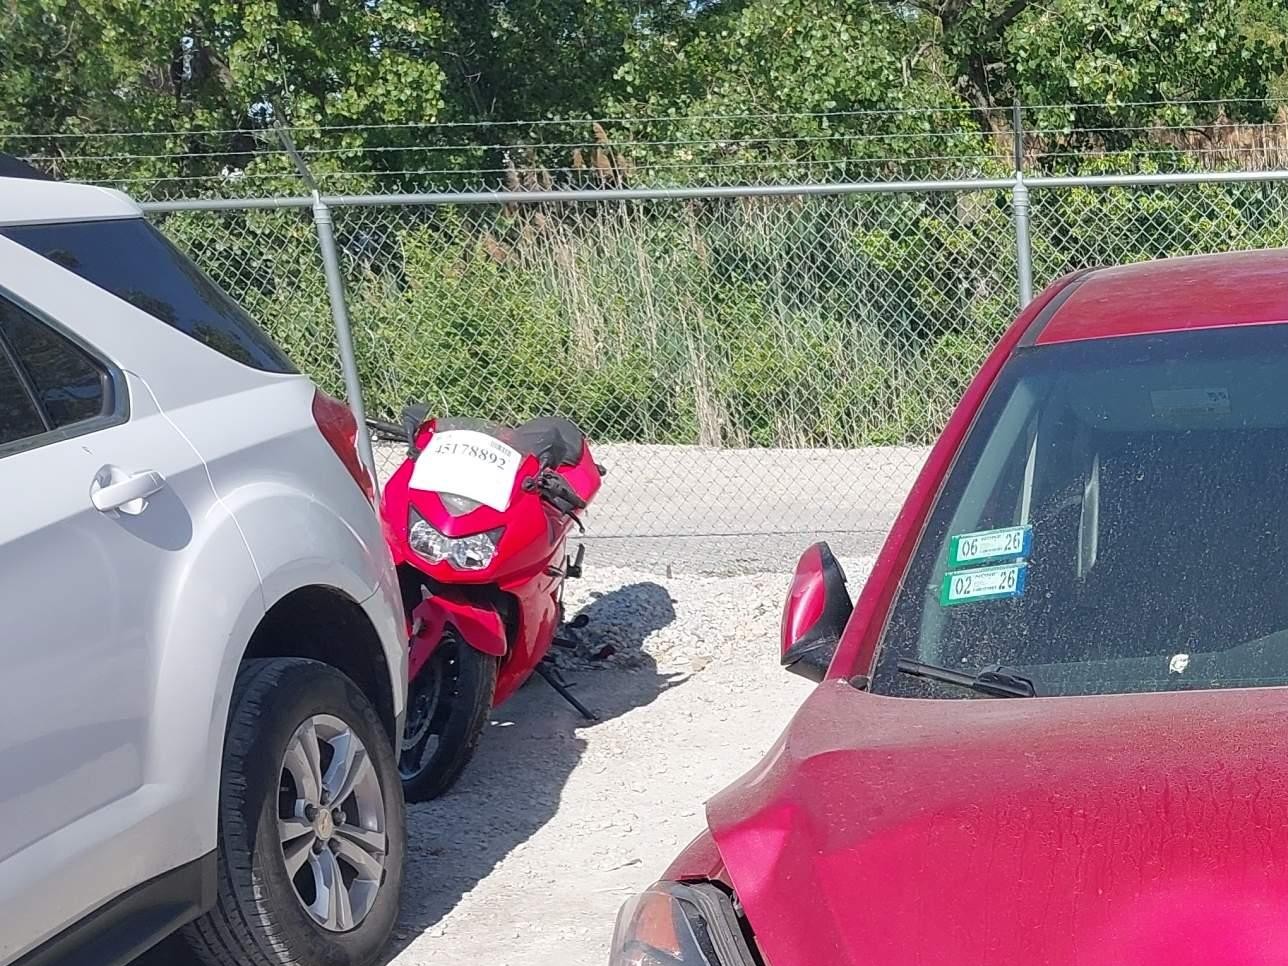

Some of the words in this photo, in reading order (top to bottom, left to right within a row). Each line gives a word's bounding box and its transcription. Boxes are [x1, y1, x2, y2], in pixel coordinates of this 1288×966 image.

[962, 538, 978, 557] 06
[1004, 531, 1021, 551] 26
[955, 575, 972, 595] 02
[998, 569, 1015, 590] 26
